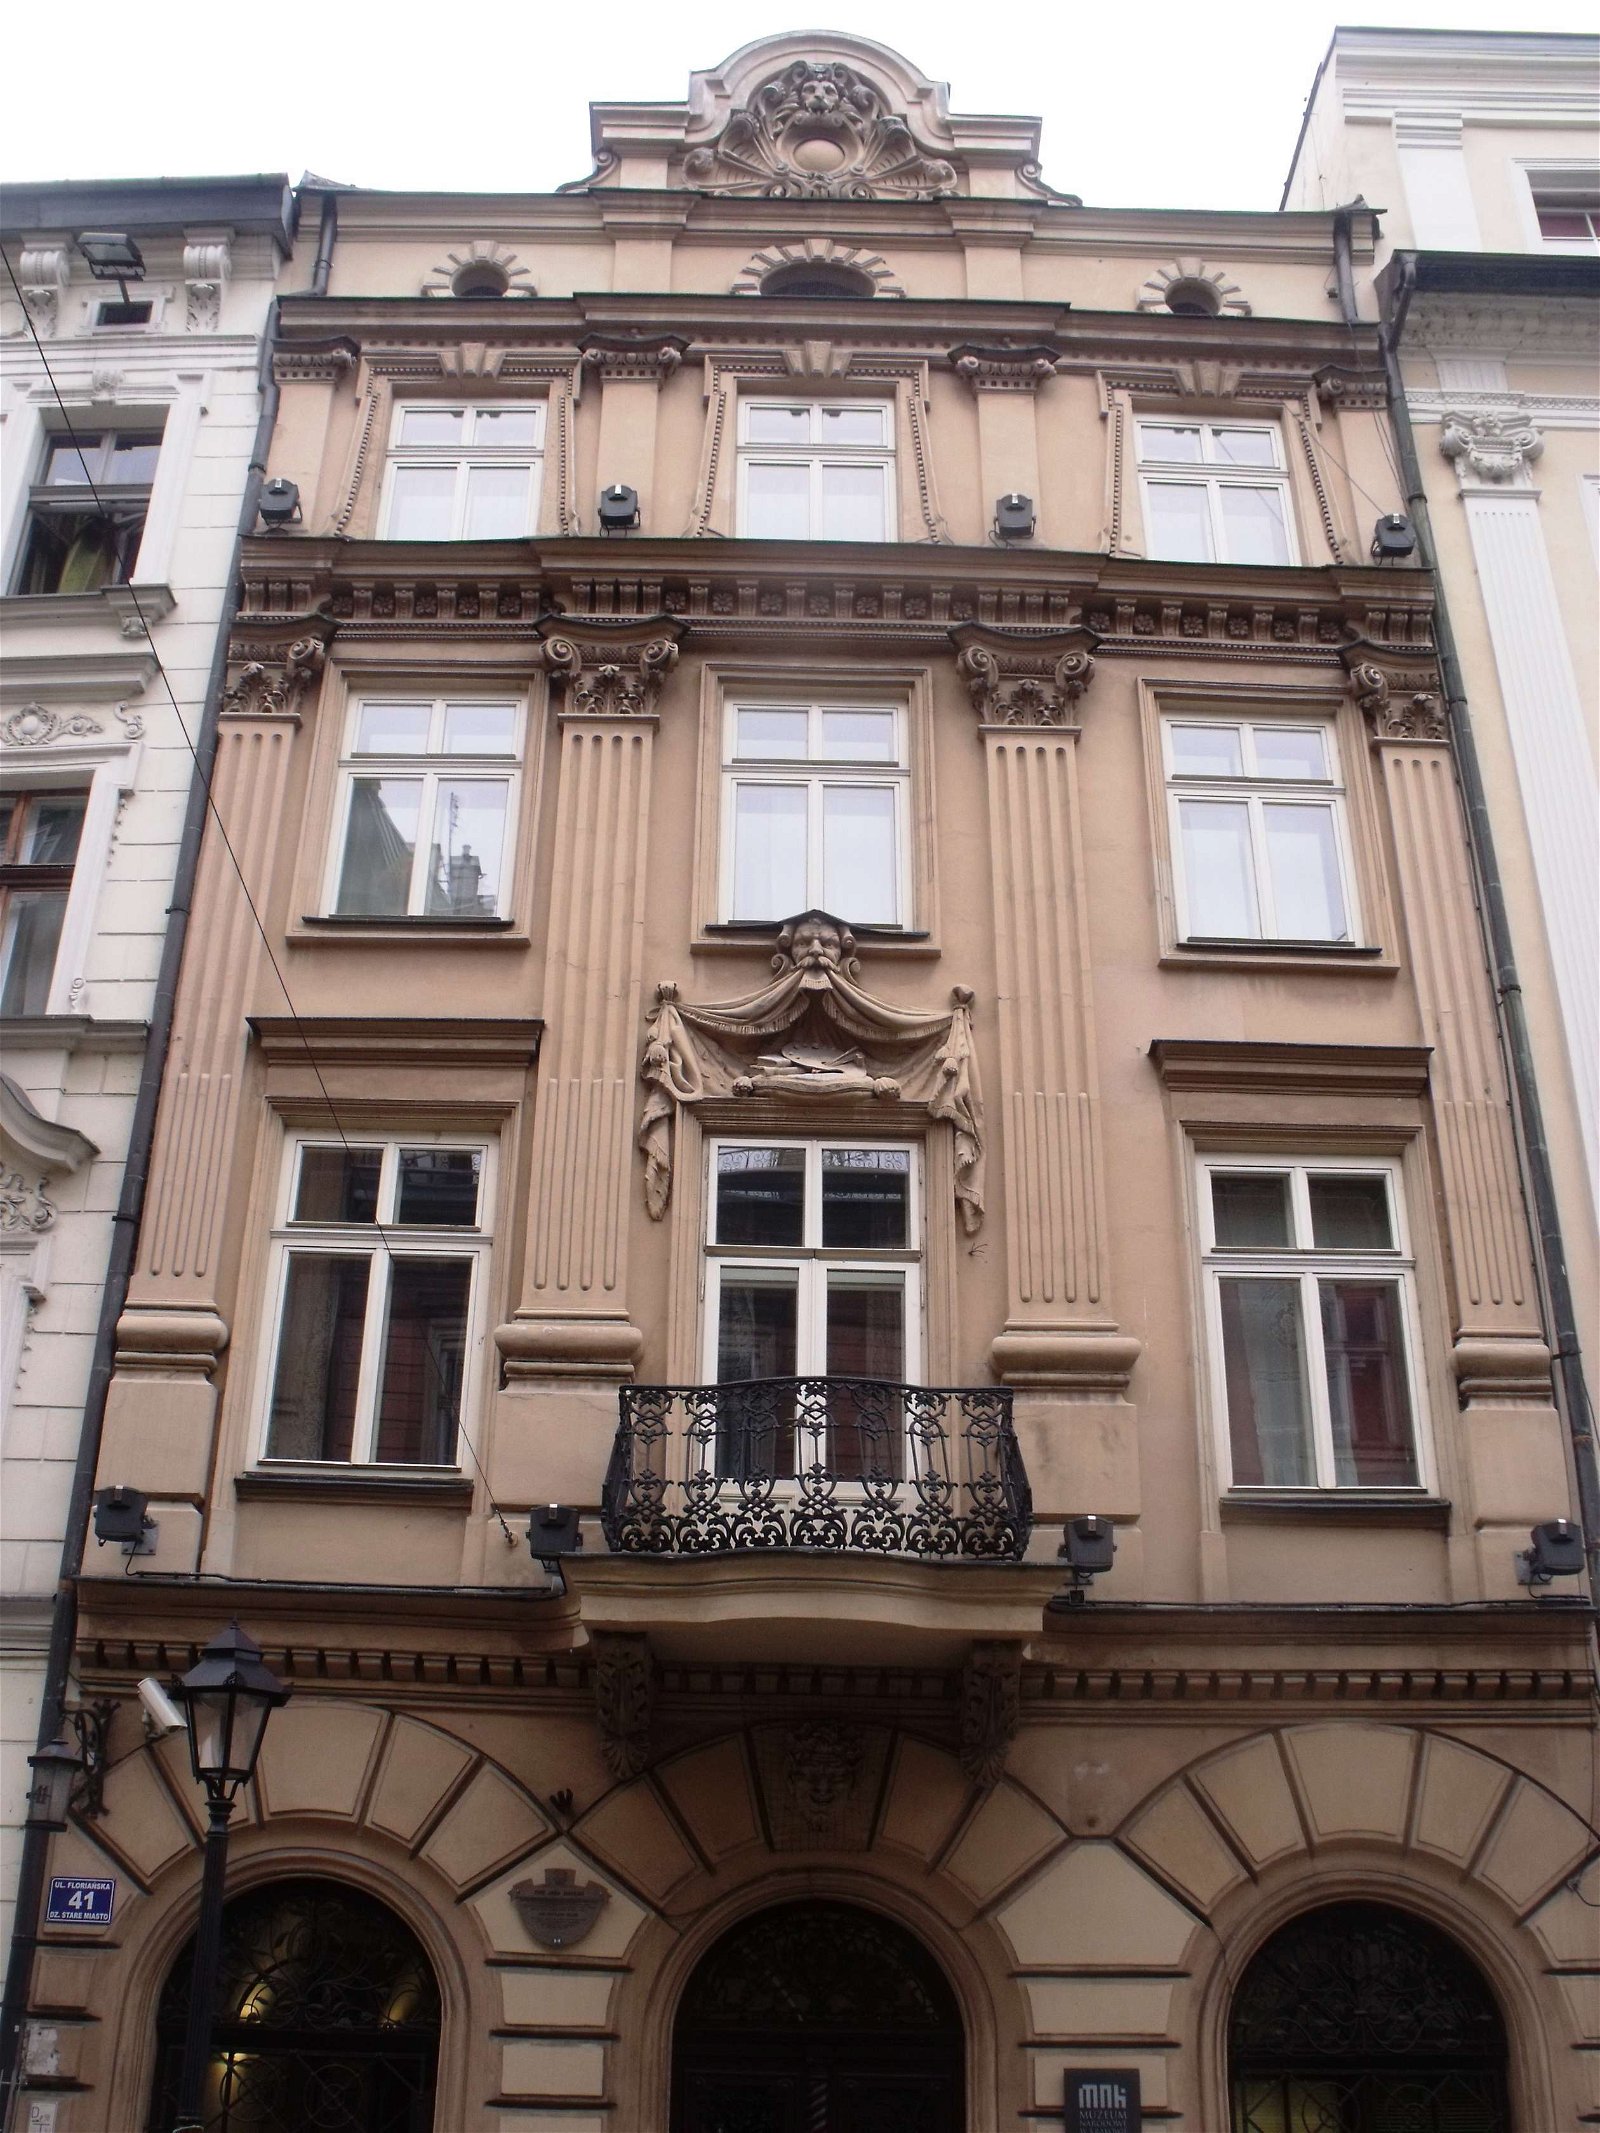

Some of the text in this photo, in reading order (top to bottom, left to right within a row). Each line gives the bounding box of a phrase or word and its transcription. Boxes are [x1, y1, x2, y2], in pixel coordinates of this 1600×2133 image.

[67, 1881, 110, 1890] FLORIAŃSKA
[68, 1890, 95, 1910] 41
[61, 1911, 83, 1919] STARE
[83, 1912, 109, 1920] MIASTO
[1079, 2110, 1128, 2119] MUZEUM
